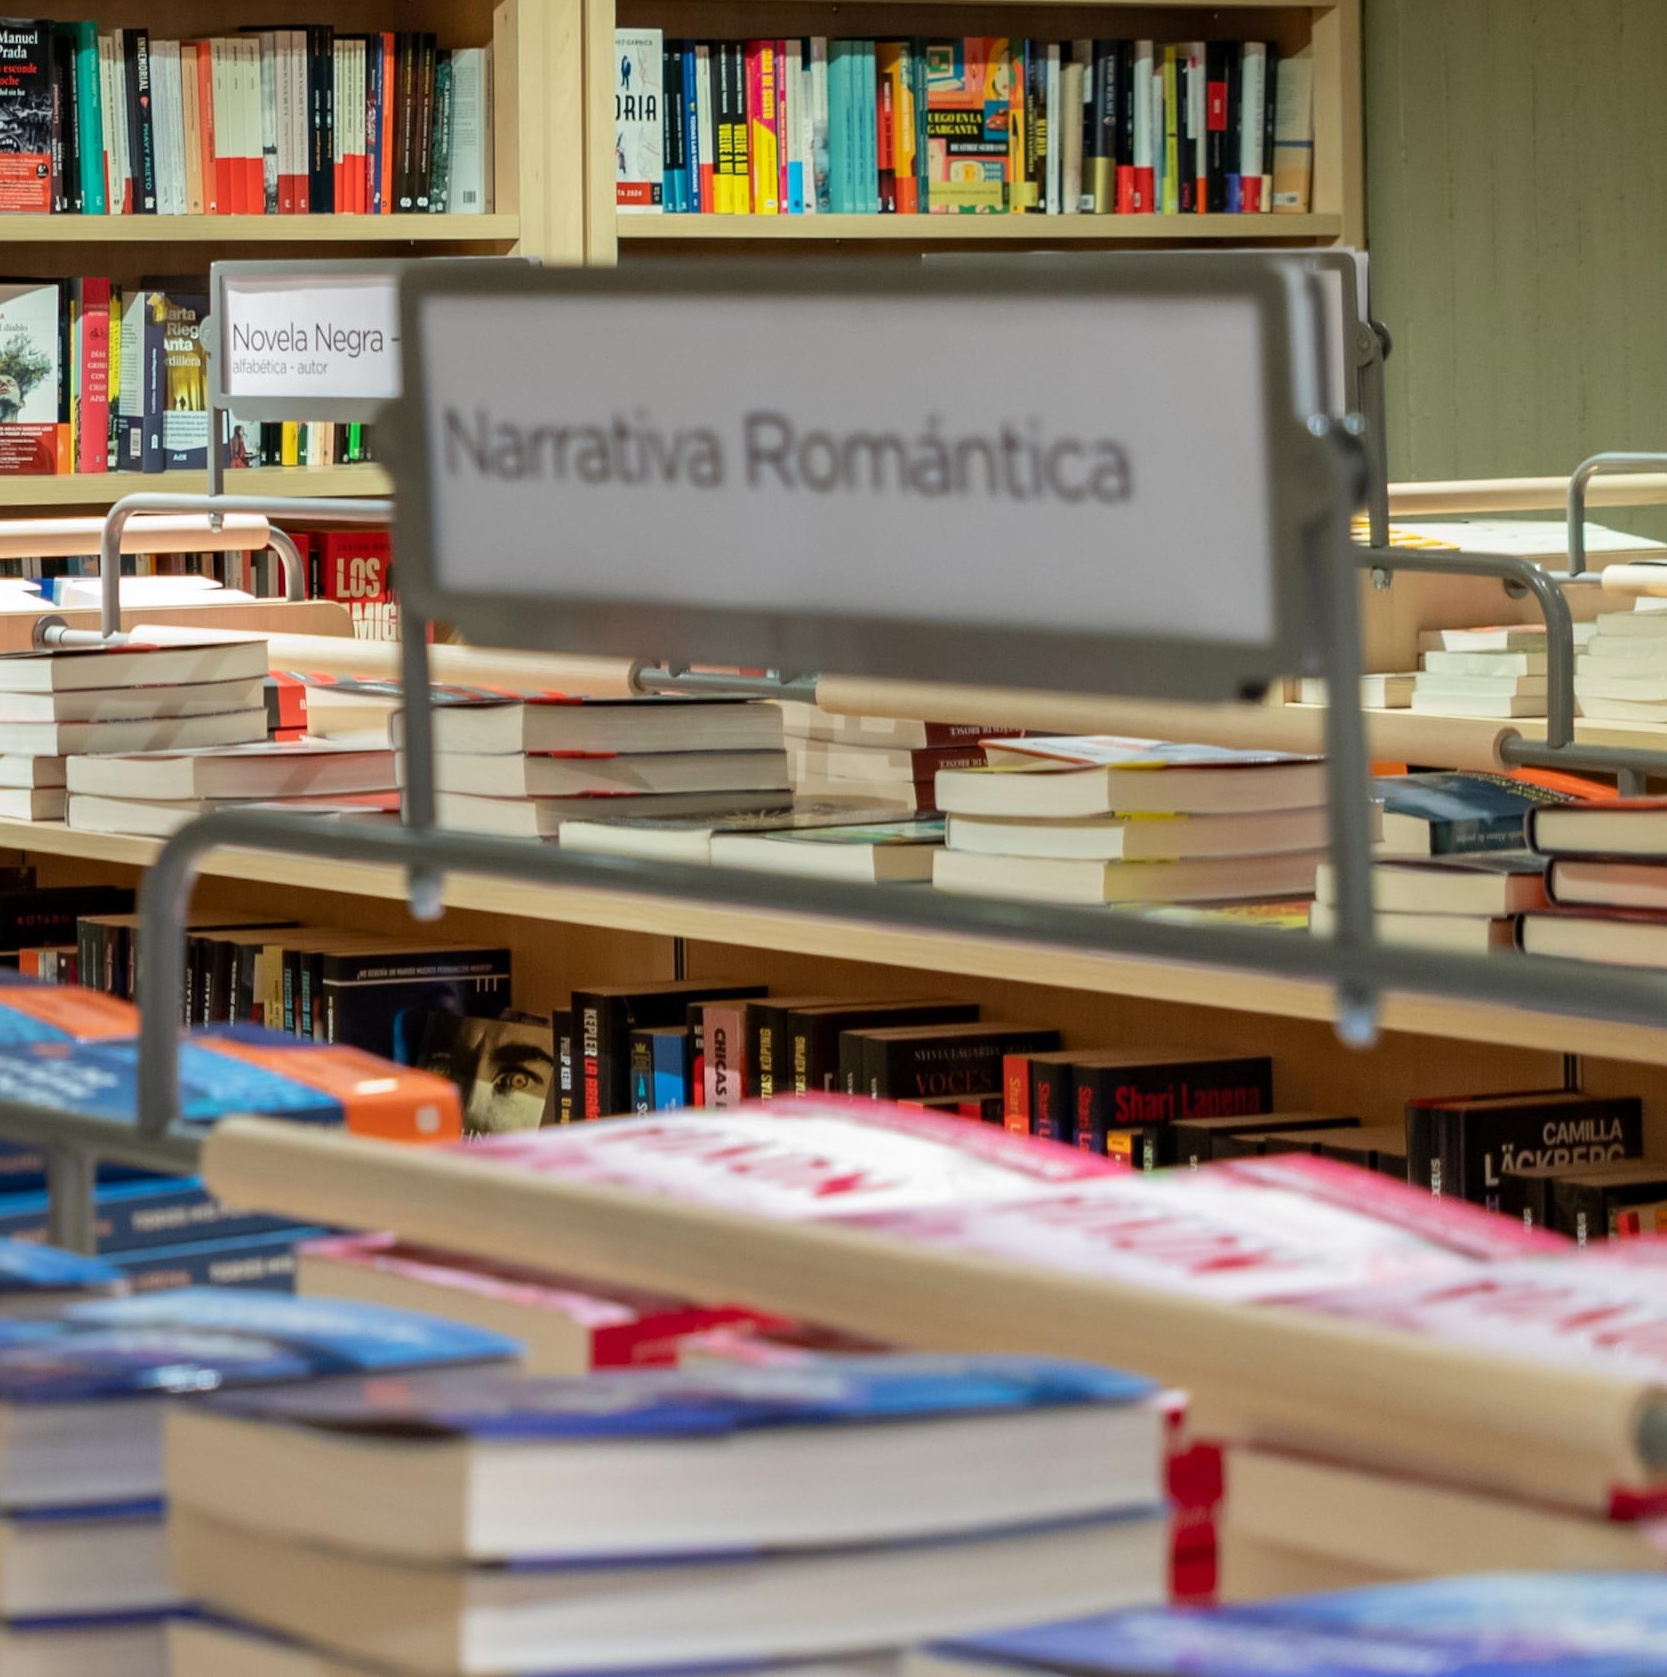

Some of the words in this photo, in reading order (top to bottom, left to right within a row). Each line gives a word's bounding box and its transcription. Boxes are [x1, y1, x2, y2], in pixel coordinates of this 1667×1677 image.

[3, 63, 37, 73] esconde
[233, 322, 308, 352] Novela
[316, 322, 383, 358] Negra
[232, 361, 287, 374] alfabética
[297, 362, 328, 374] autor
[441, 402, 726, 490] Narrativa
[741, 408, 1136, 505] Romántica
[336, 557, 381, 598] LOS
[584, 1008, 598, 1057] KEPLER
[714, 1027, 727, 1096] CHICAS
[1114, 1084, 1175, 1125] Shari
[1543, 1118, 1623, 1146] CAMILLA
